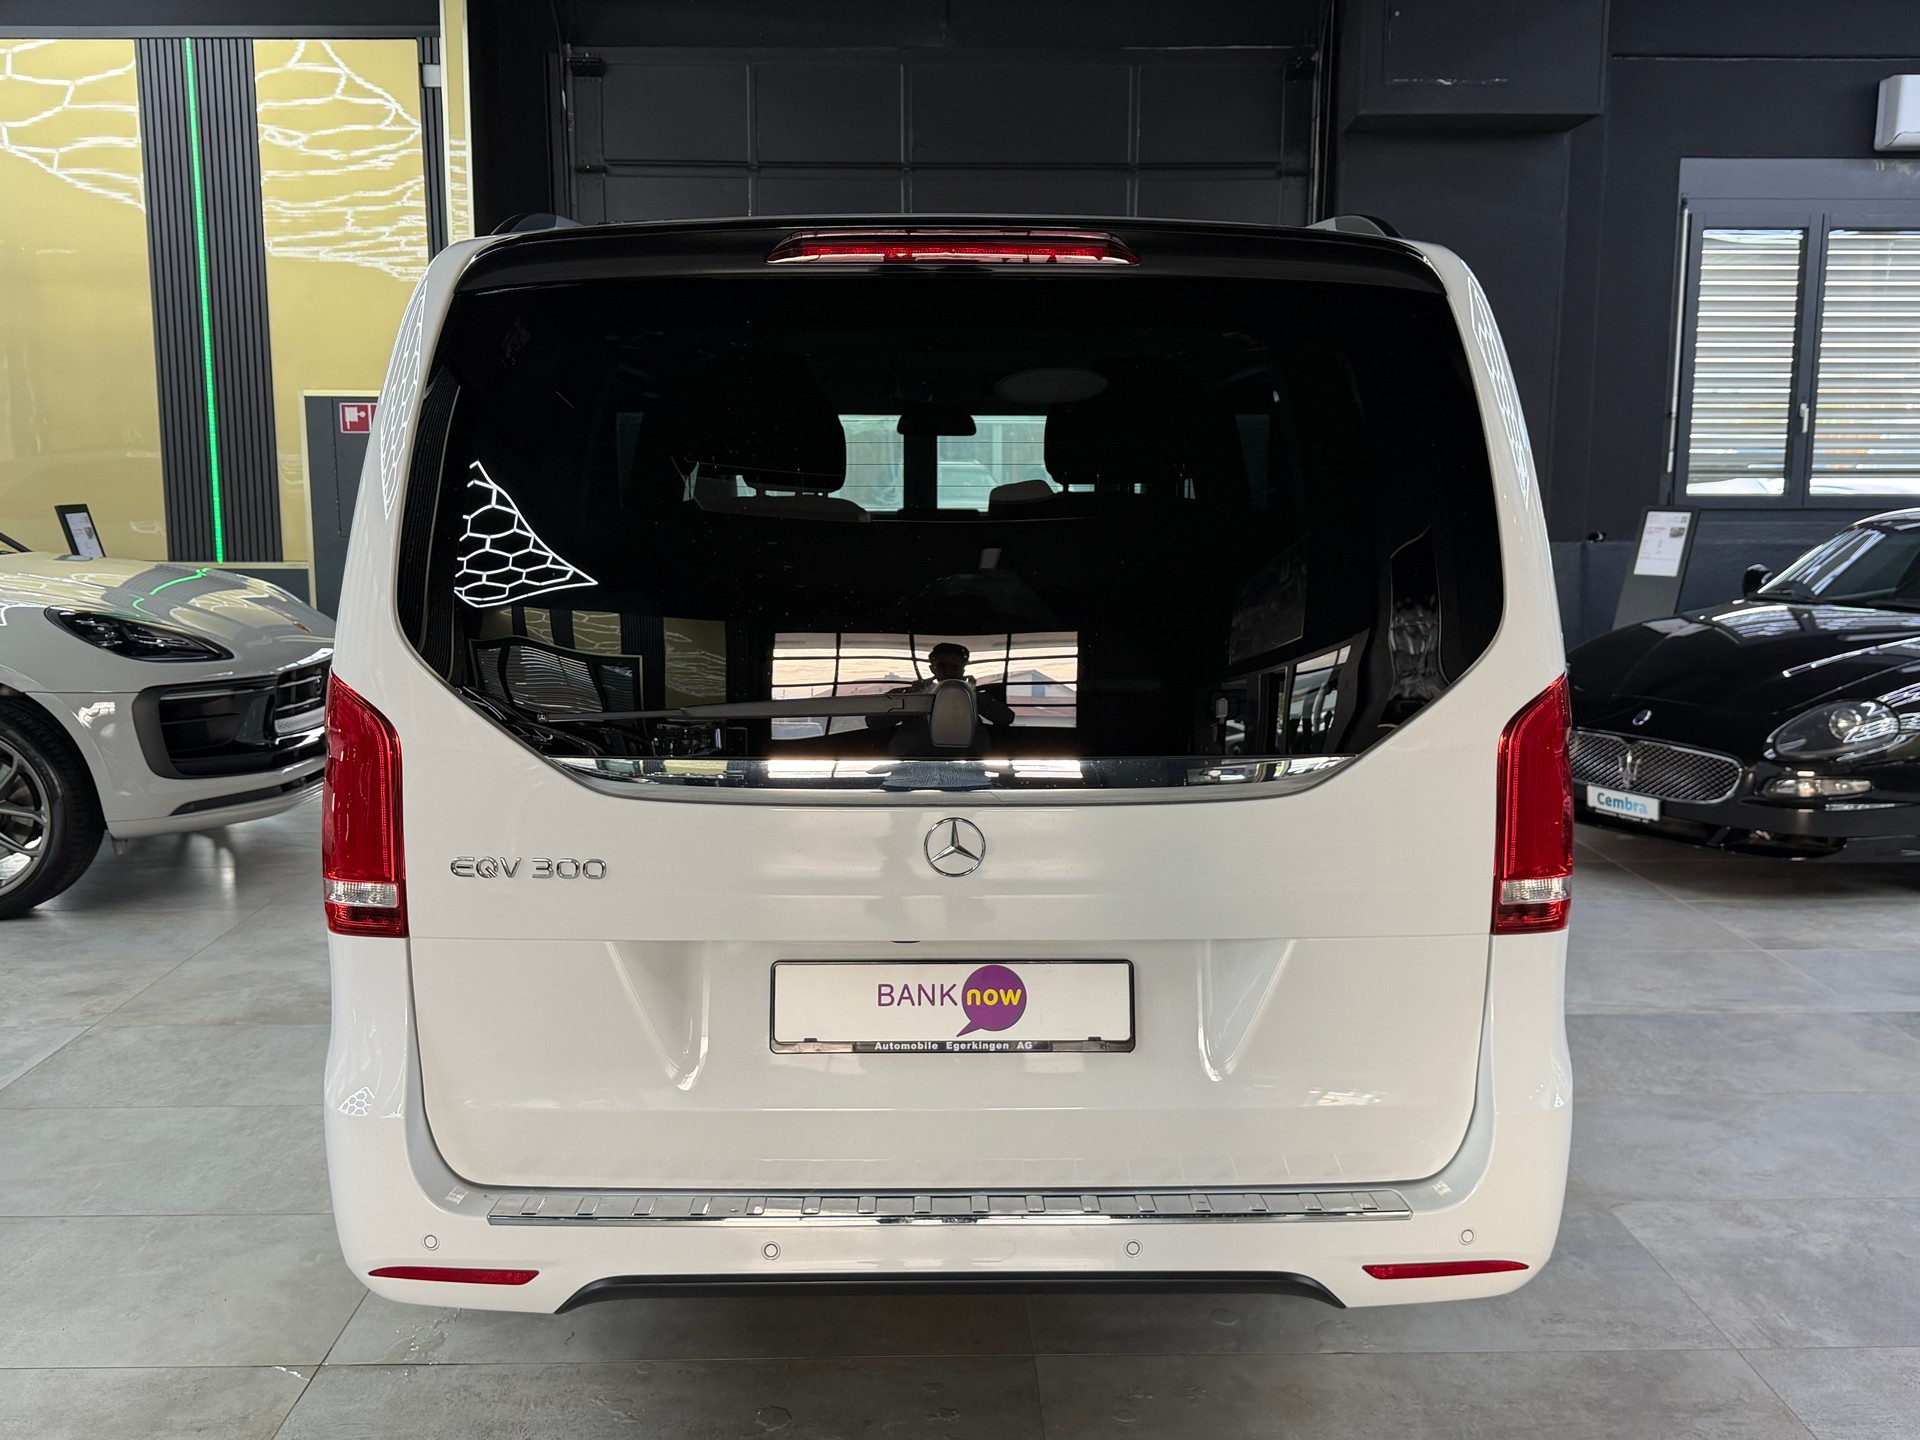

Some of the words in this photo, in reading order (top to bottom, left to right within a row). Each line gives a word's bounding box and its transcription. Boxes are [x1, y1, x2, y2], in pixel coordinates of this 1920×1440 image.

[1597, 792, 1648, 815] Cembra
[450, 856, 522, 878] EQV
[532, 857, 607, 880] 300
[877, 983, 958, 1007] BANK
[966, 988, 1022, 1006] now
[874, 1041, 939, 1050] Automobile
[946, 1041, 1009, 1051] Egerkingen
[1017, 1041, 1033, 1050] AG
